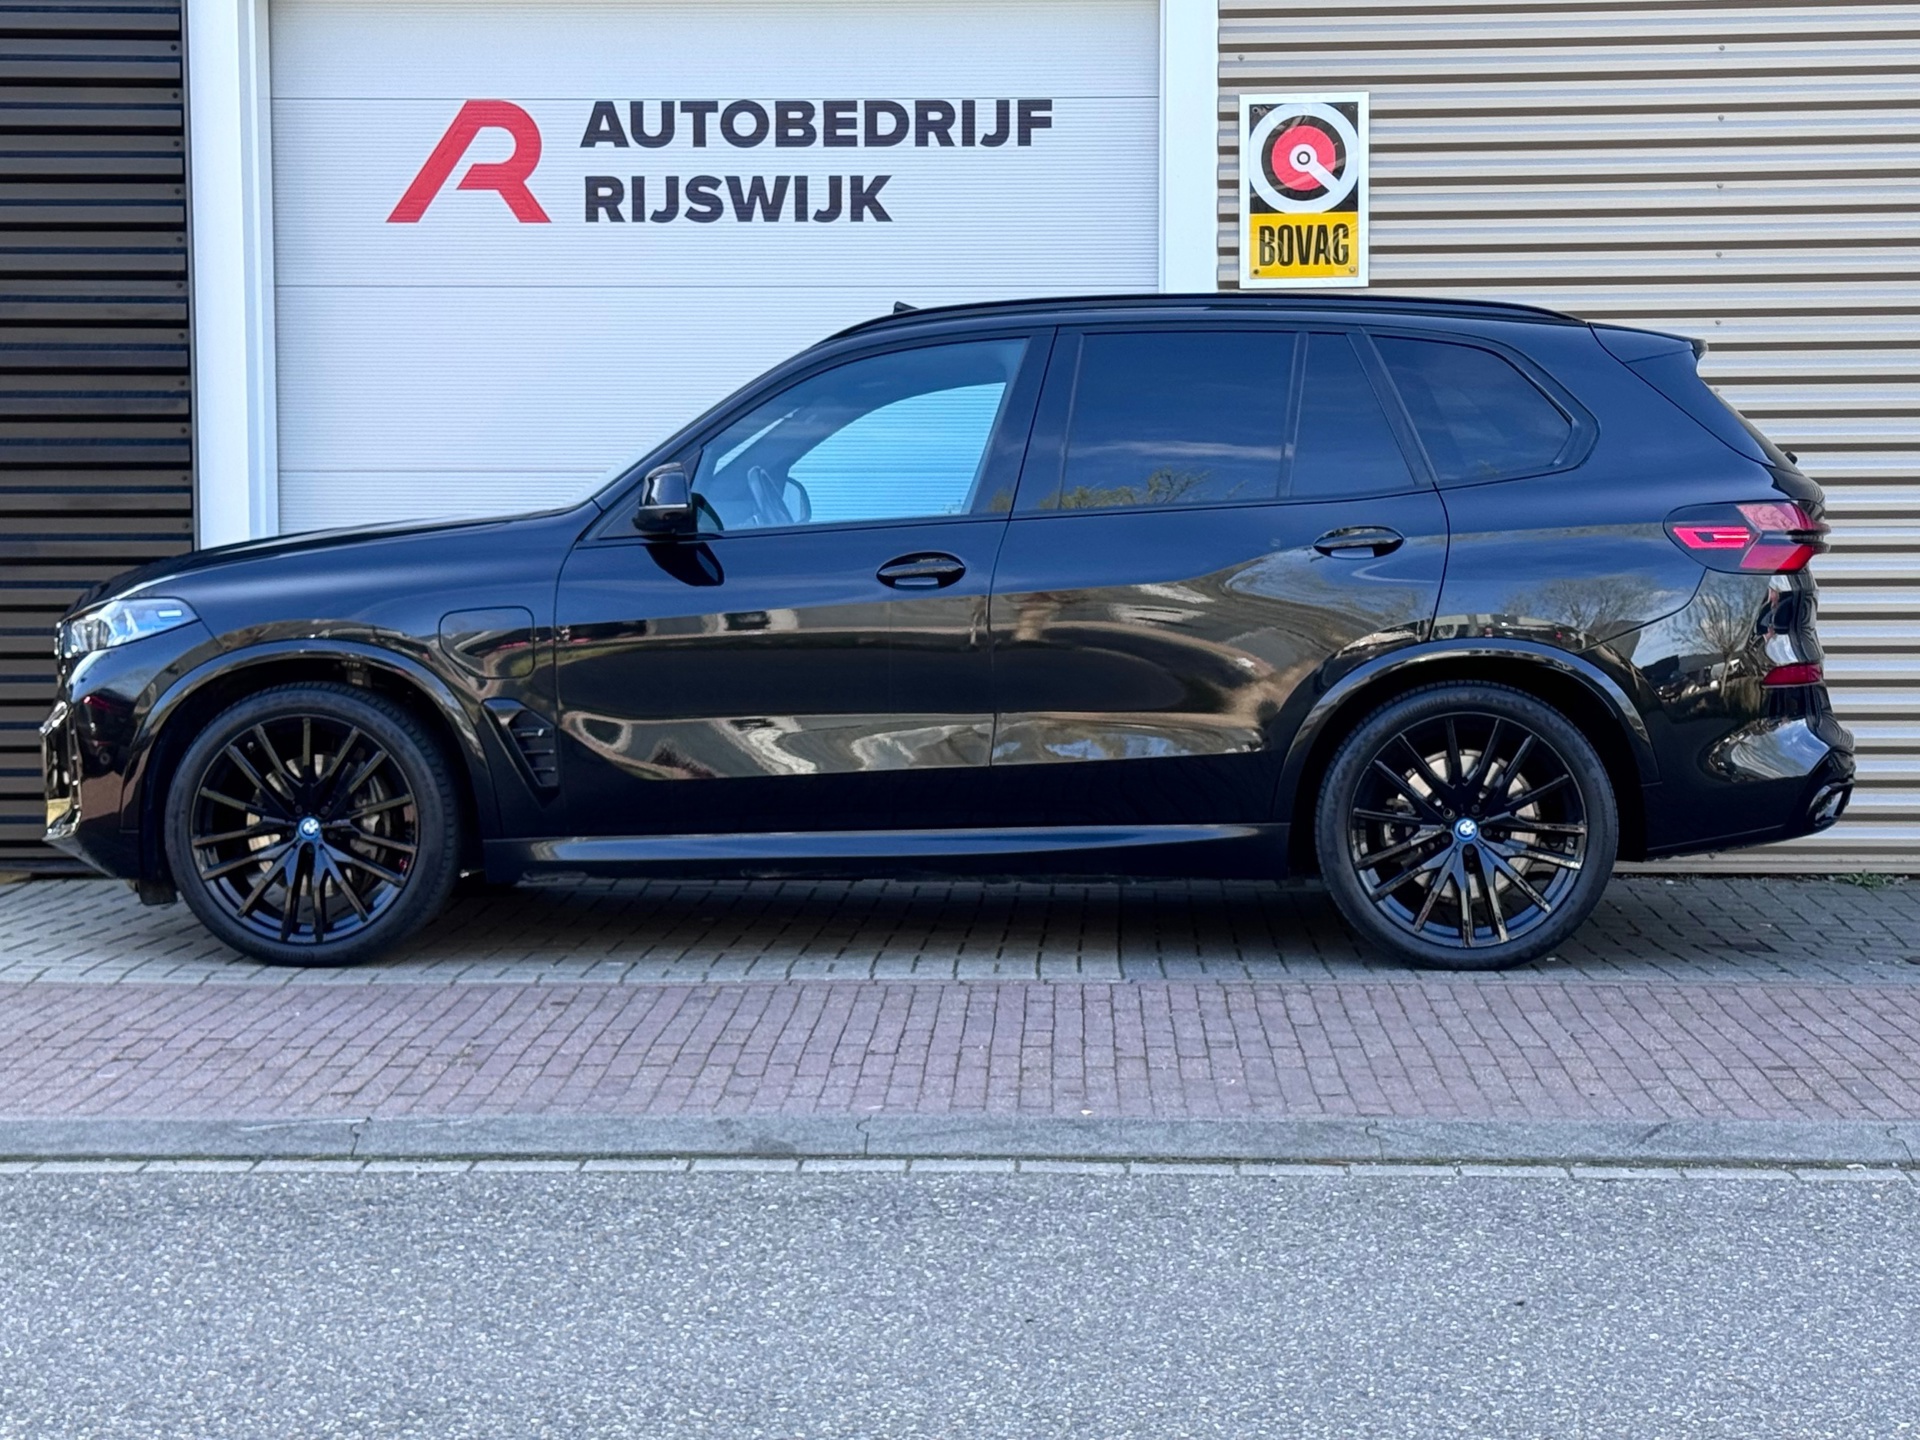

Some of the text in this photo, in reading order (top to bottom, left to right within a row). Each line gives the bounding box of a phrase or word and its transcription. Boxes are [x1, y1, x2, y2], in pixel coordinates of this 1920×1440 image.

[581, 99, 1053, 149] AUTOBEDRIJF
[585, 175, 892, 223] RIJSWIJK
[1259, 223, 1349, 267] BOVAG
